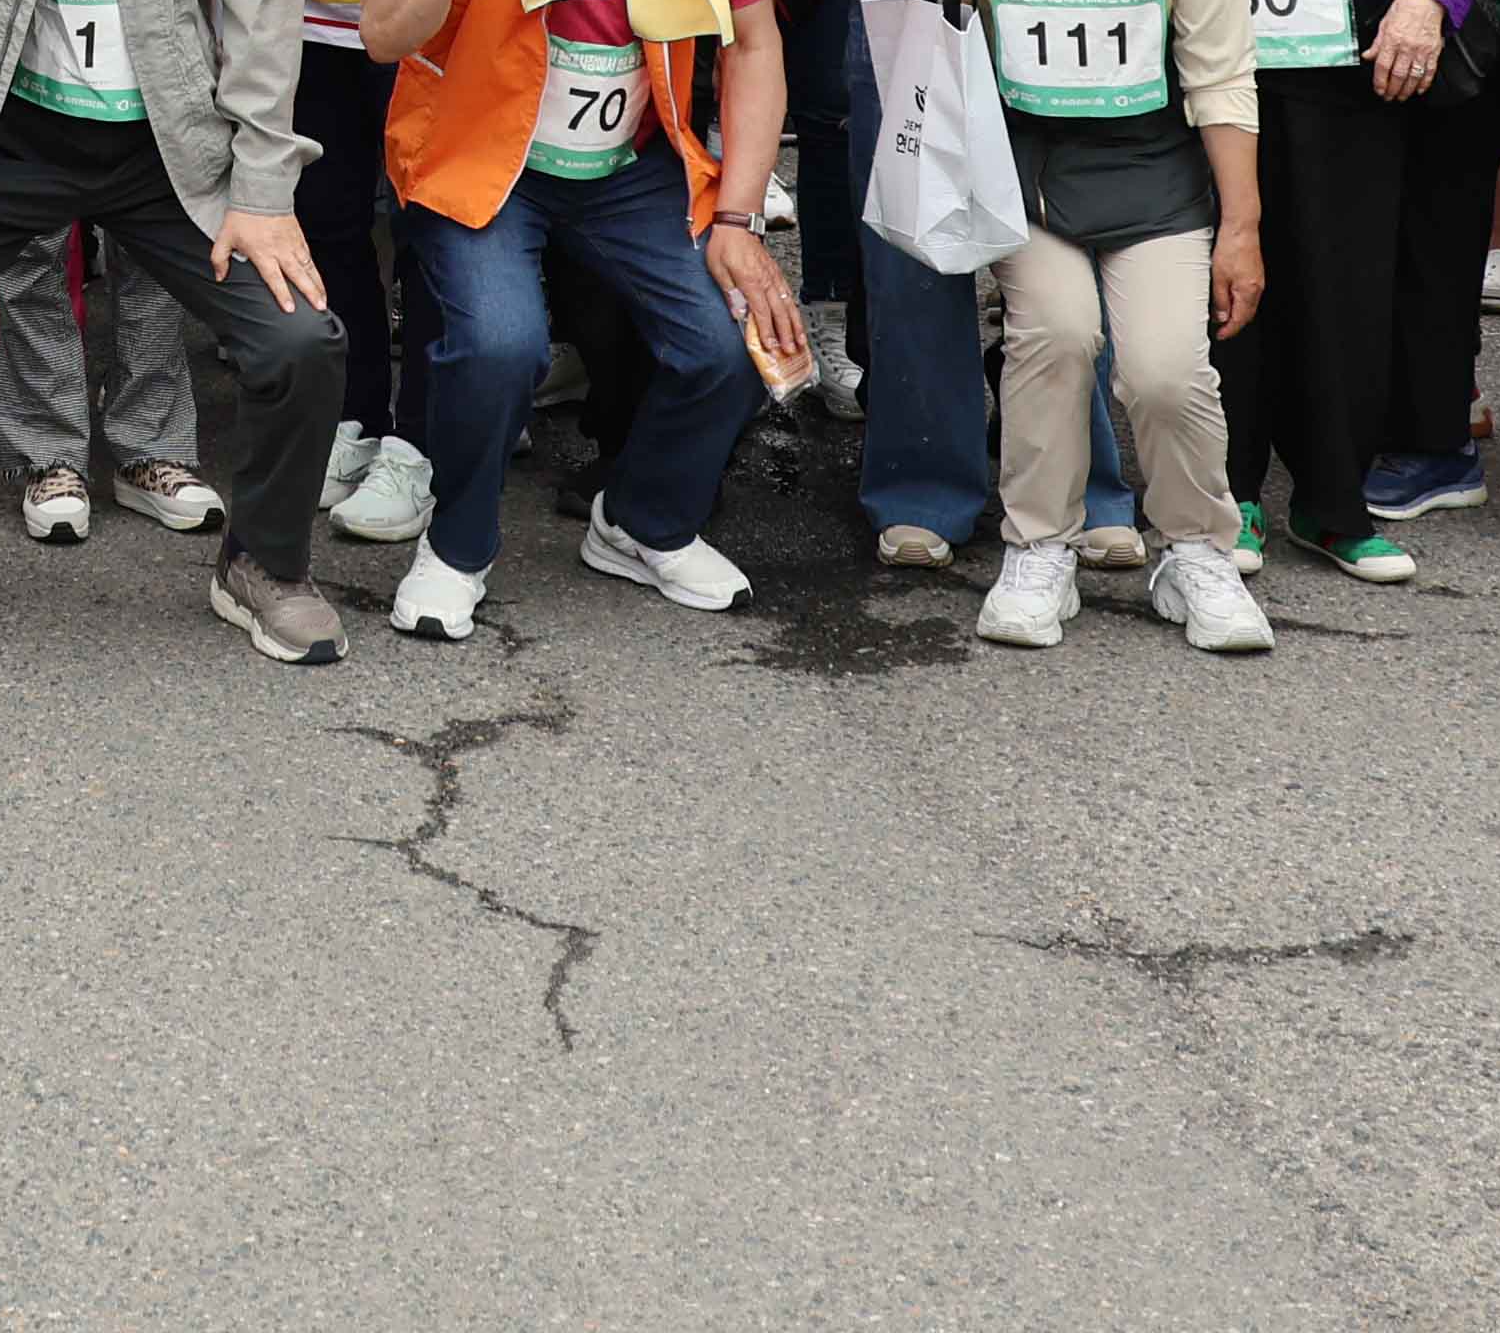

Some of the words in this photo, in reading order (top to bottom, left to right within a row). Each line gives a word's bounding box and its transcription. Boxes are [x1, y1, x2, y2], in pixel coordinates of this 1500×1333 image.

[75, 21, 96, 68] 1
[1027, 21, 1127, 67] 111
[567, 87, 628, 132] 70
